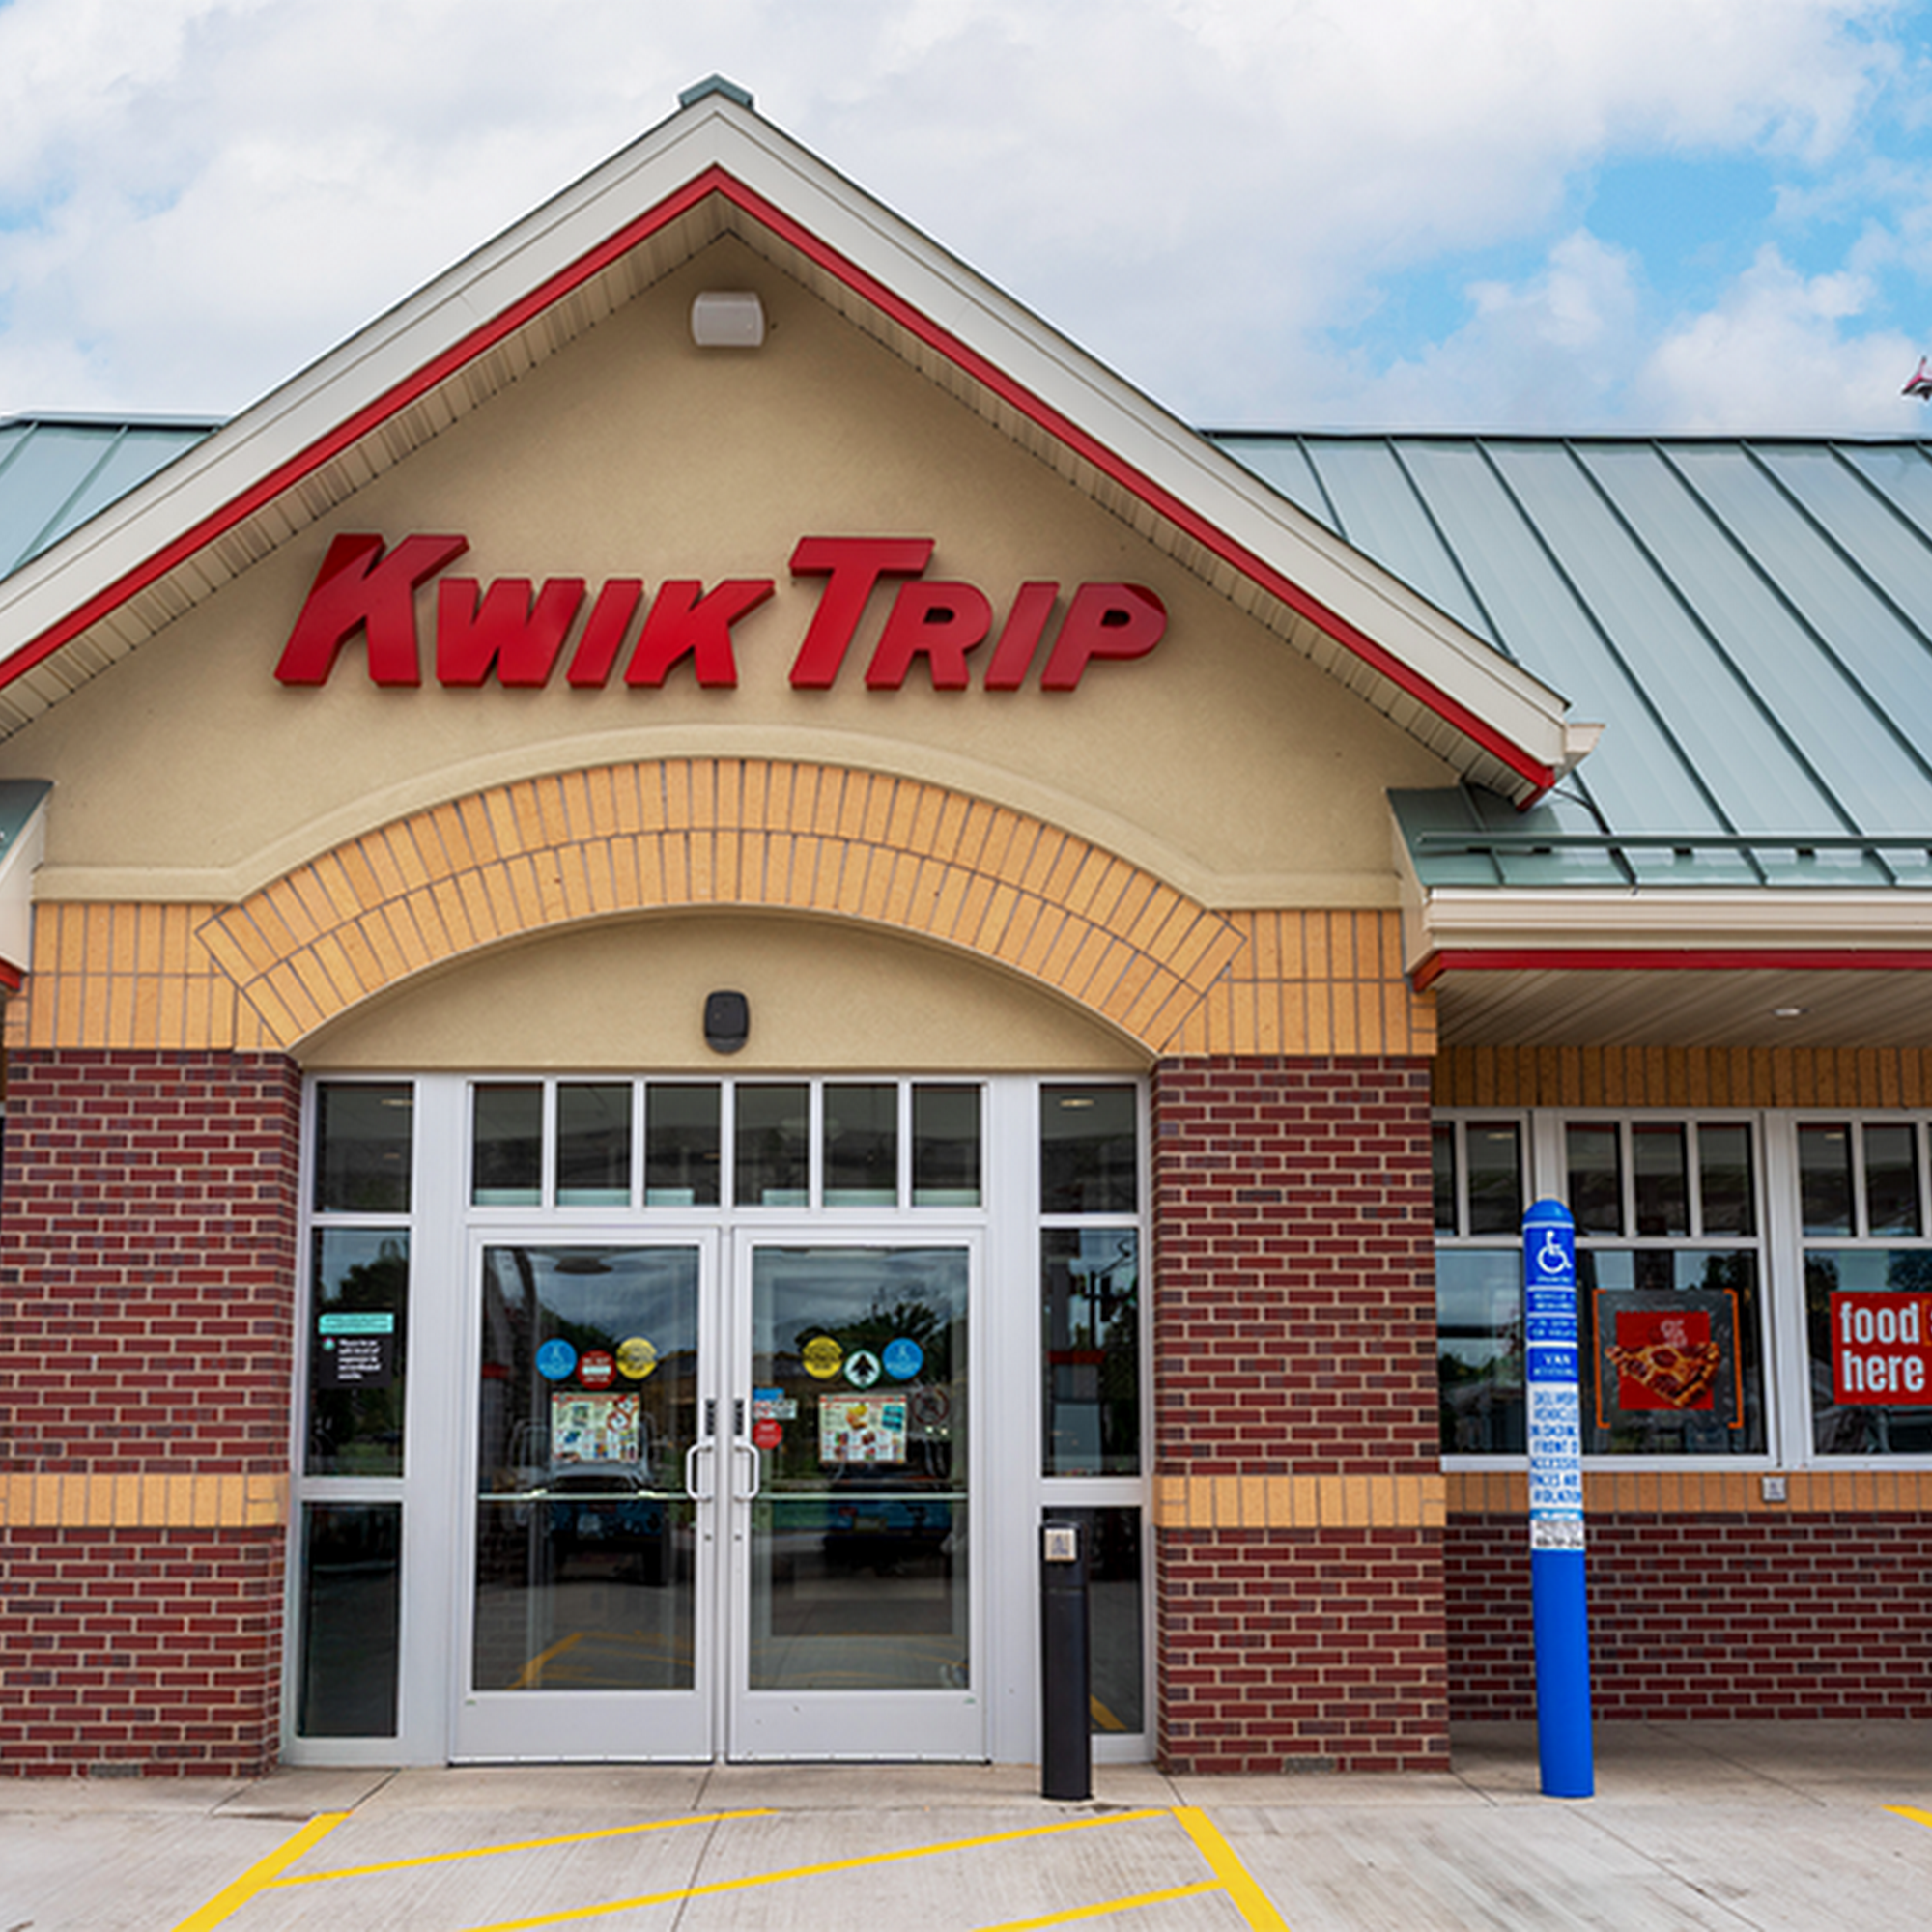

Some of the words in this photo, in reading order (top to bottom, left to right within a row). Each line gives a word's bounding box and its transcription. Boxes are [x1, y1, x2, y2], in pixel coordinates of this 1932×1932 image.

[274, 533, 776, 688] KWIK
[788, 536, 1168, 692] TRIP
[1839, 1301, 1919, 1344] food
[1842, 1350, 1924, 1391] here
